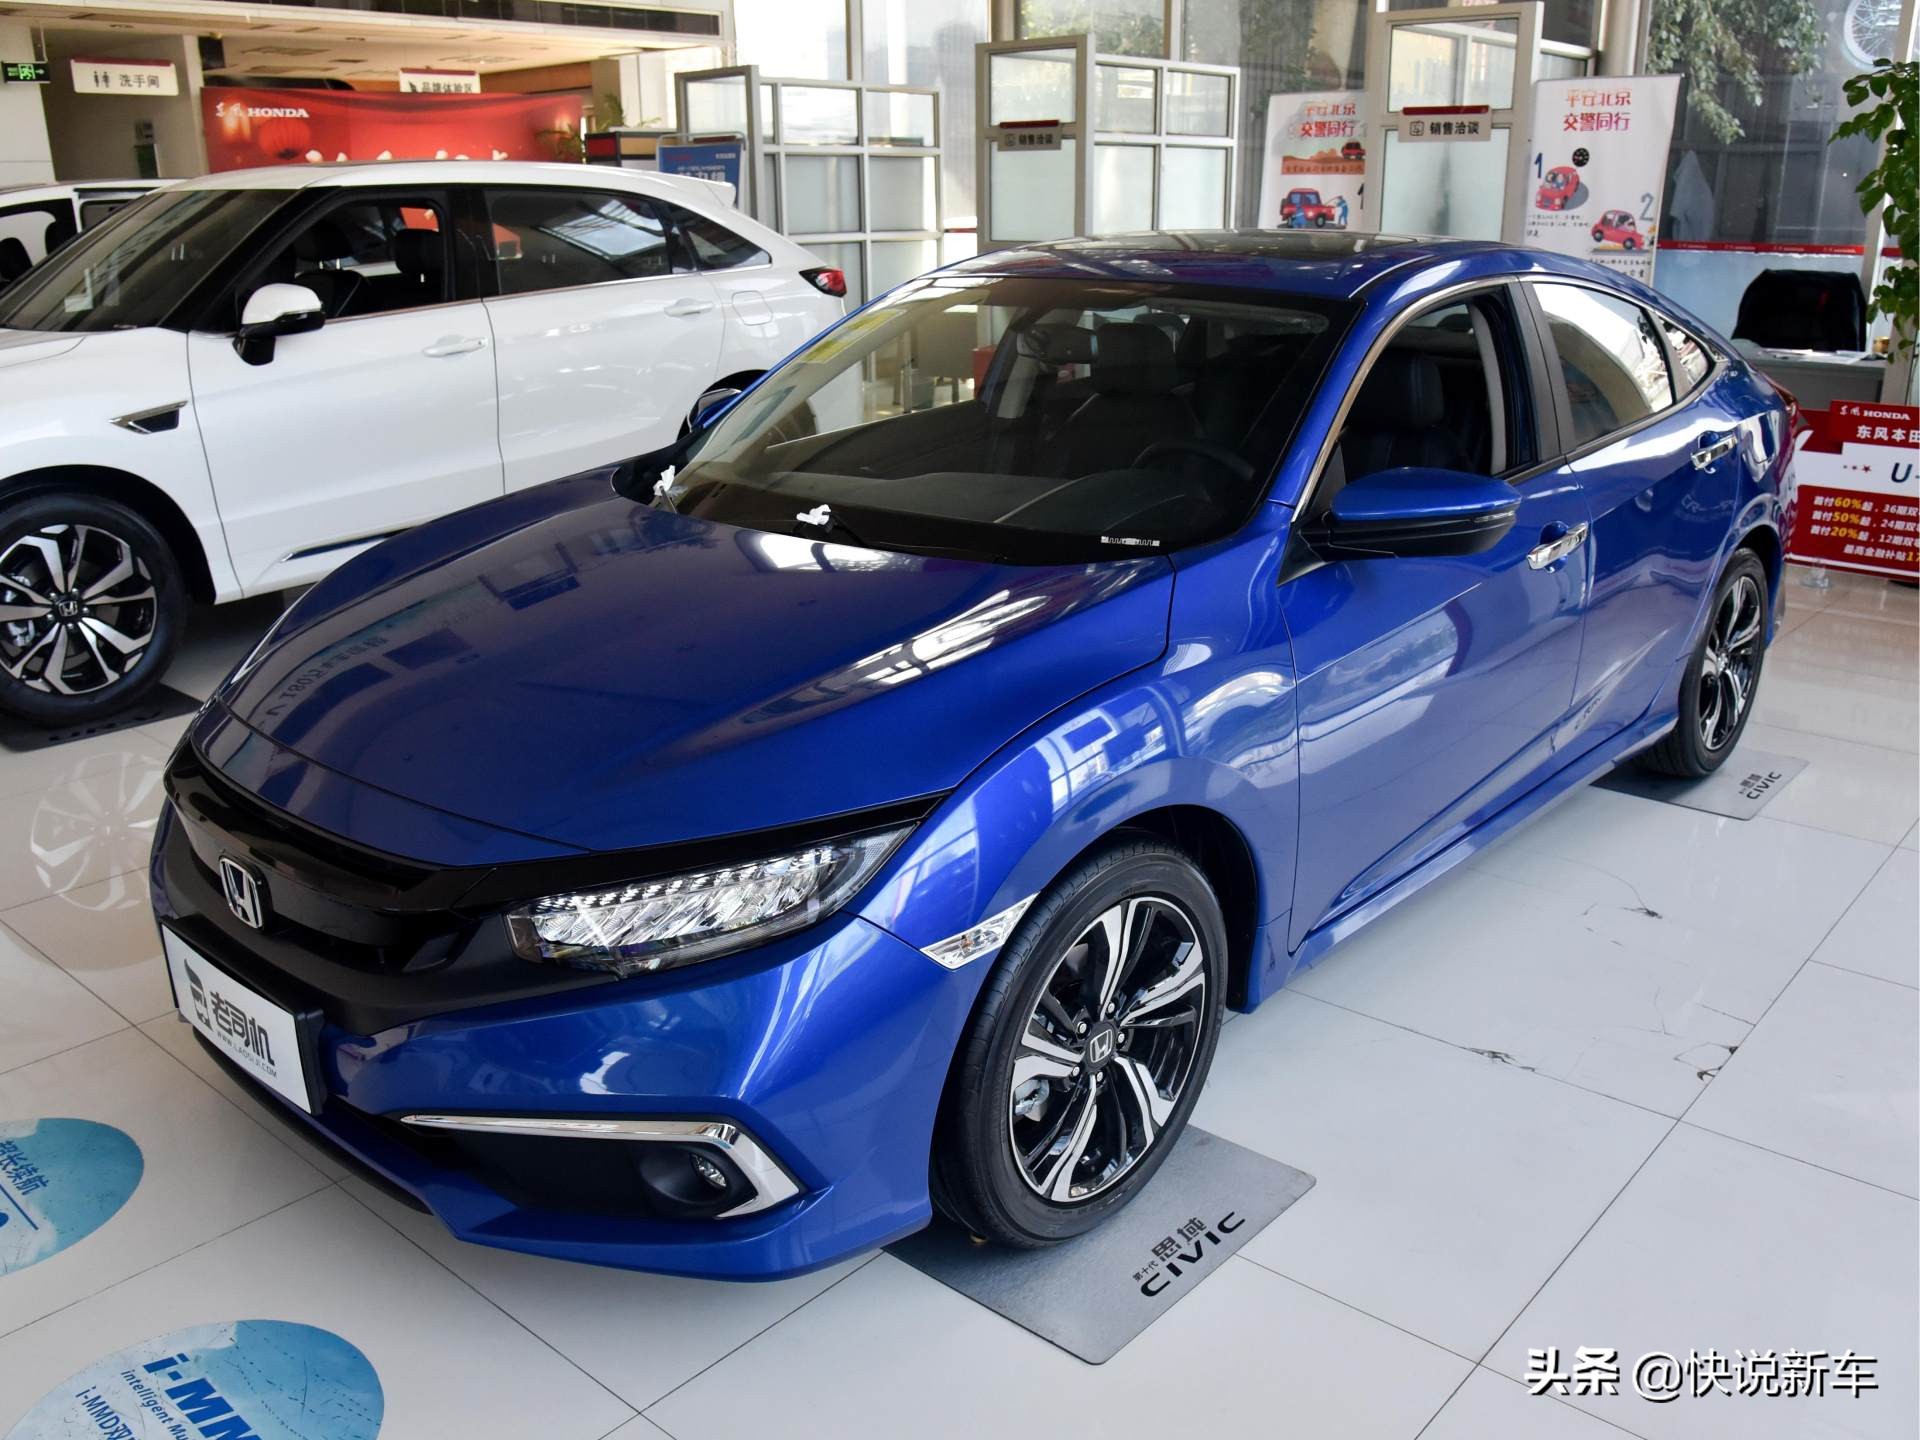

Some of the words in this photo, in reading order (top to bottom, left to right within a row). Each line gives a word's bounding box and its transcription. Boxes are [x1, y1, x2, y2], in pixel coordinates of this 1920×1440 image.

[119, 74, 160, 88] 洗手间
[248, 107, 309, 118] HONDA
[1563, 111, 1630, 132] 交警同行
[1301, 120, 1355, 138] 交警同行
[1430, 121, 1479, 135] 销售洽谈
[1534, 152, 1543, 179] 1
[1639, 192, 1655, 221] 2
[1863, 409, 1911, 421] HONDA
[1746, 771, 1782, 799] CIVIC
[210, 989, 276, 1067] 老司机
[1132, 1260, 1159, 1282] 第十代
[1151, 1217, 1207, 1262] 思域
[1141, 1211, 1246, 1297] CIVIC
[121, 1369, 174, 1424] intelligent
